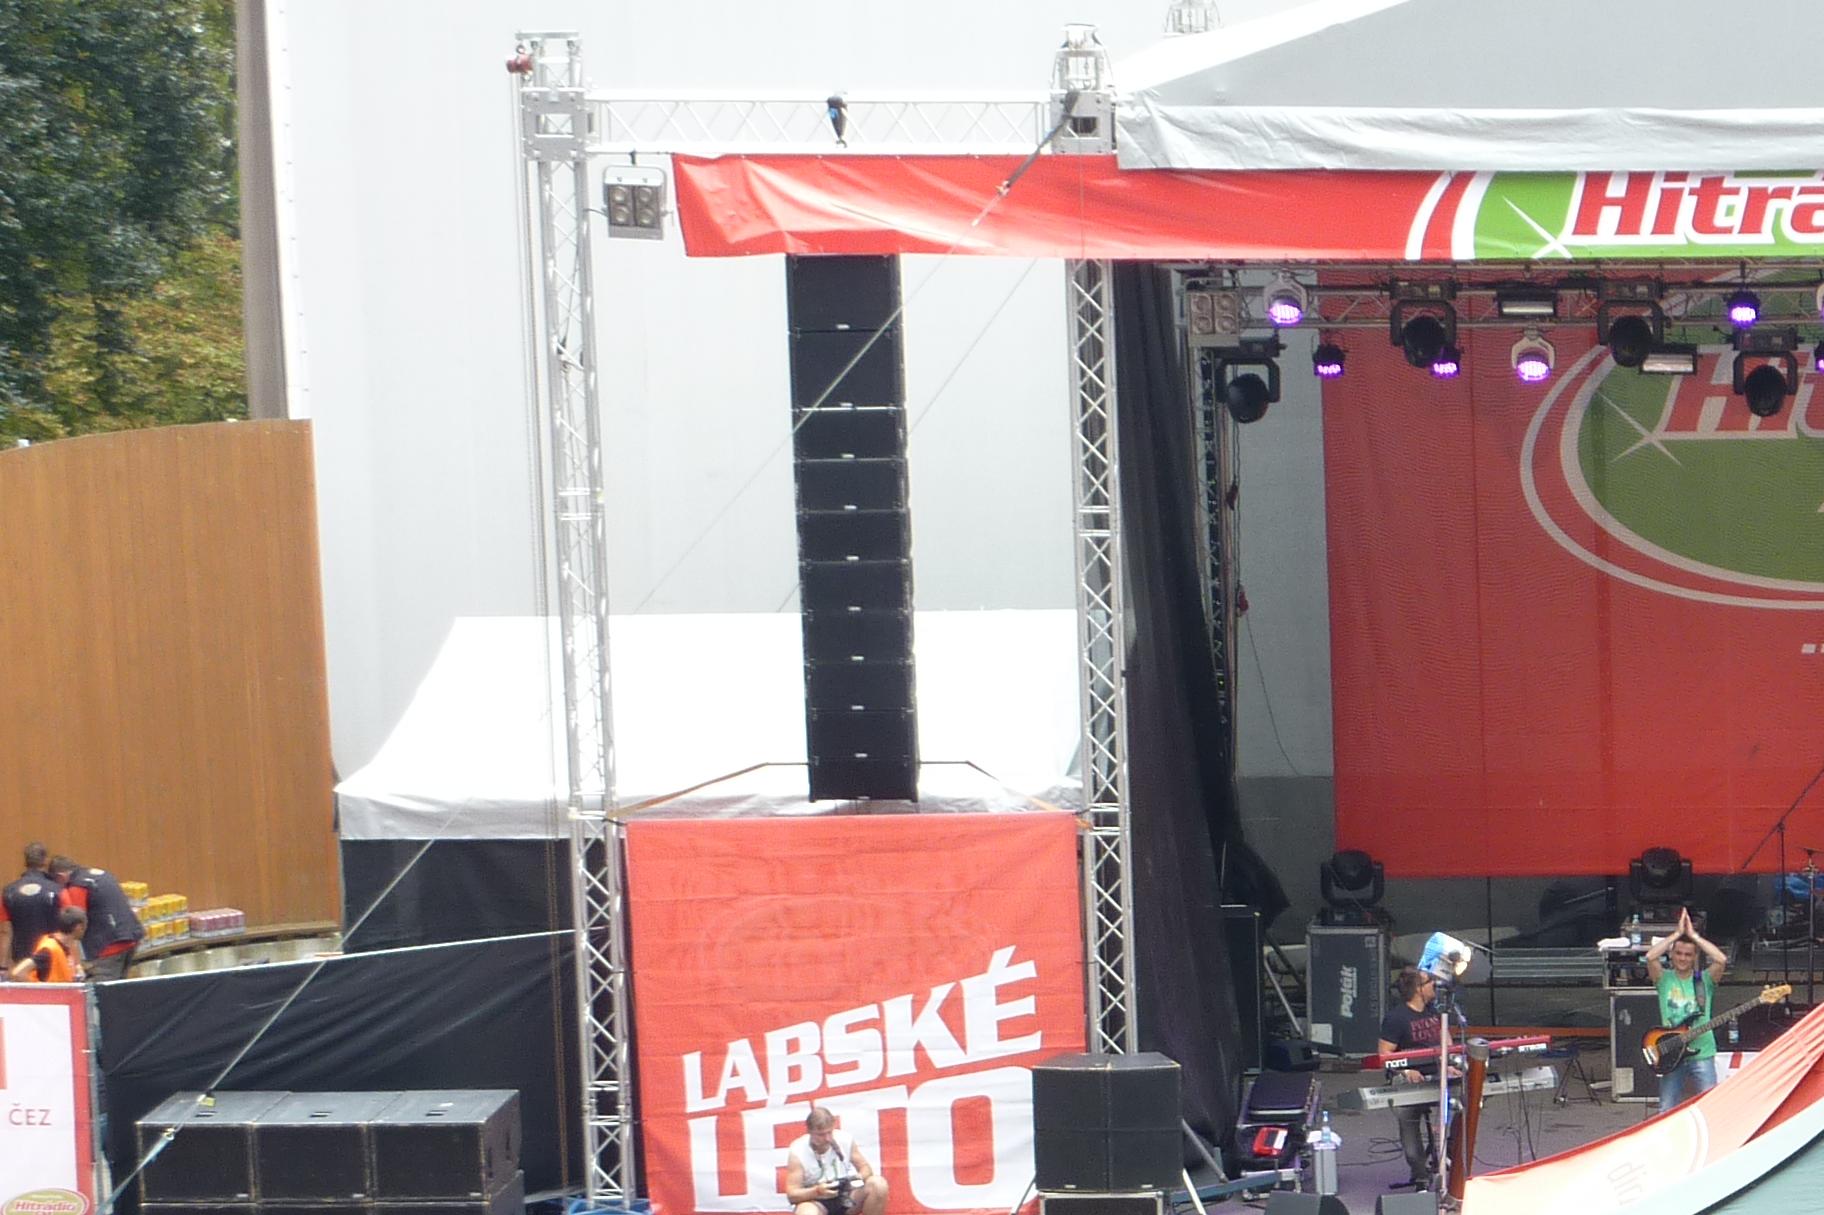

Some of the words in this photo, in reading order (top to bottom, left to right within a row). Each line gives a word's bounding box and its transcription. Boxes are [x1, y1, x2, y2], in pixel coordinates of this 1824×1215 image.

[681, 944, 1043, 1114] LABSKÉ
[1385, 1058, 1408, 1069] nord
[8, 1102, 52, 1126] ČEZ
